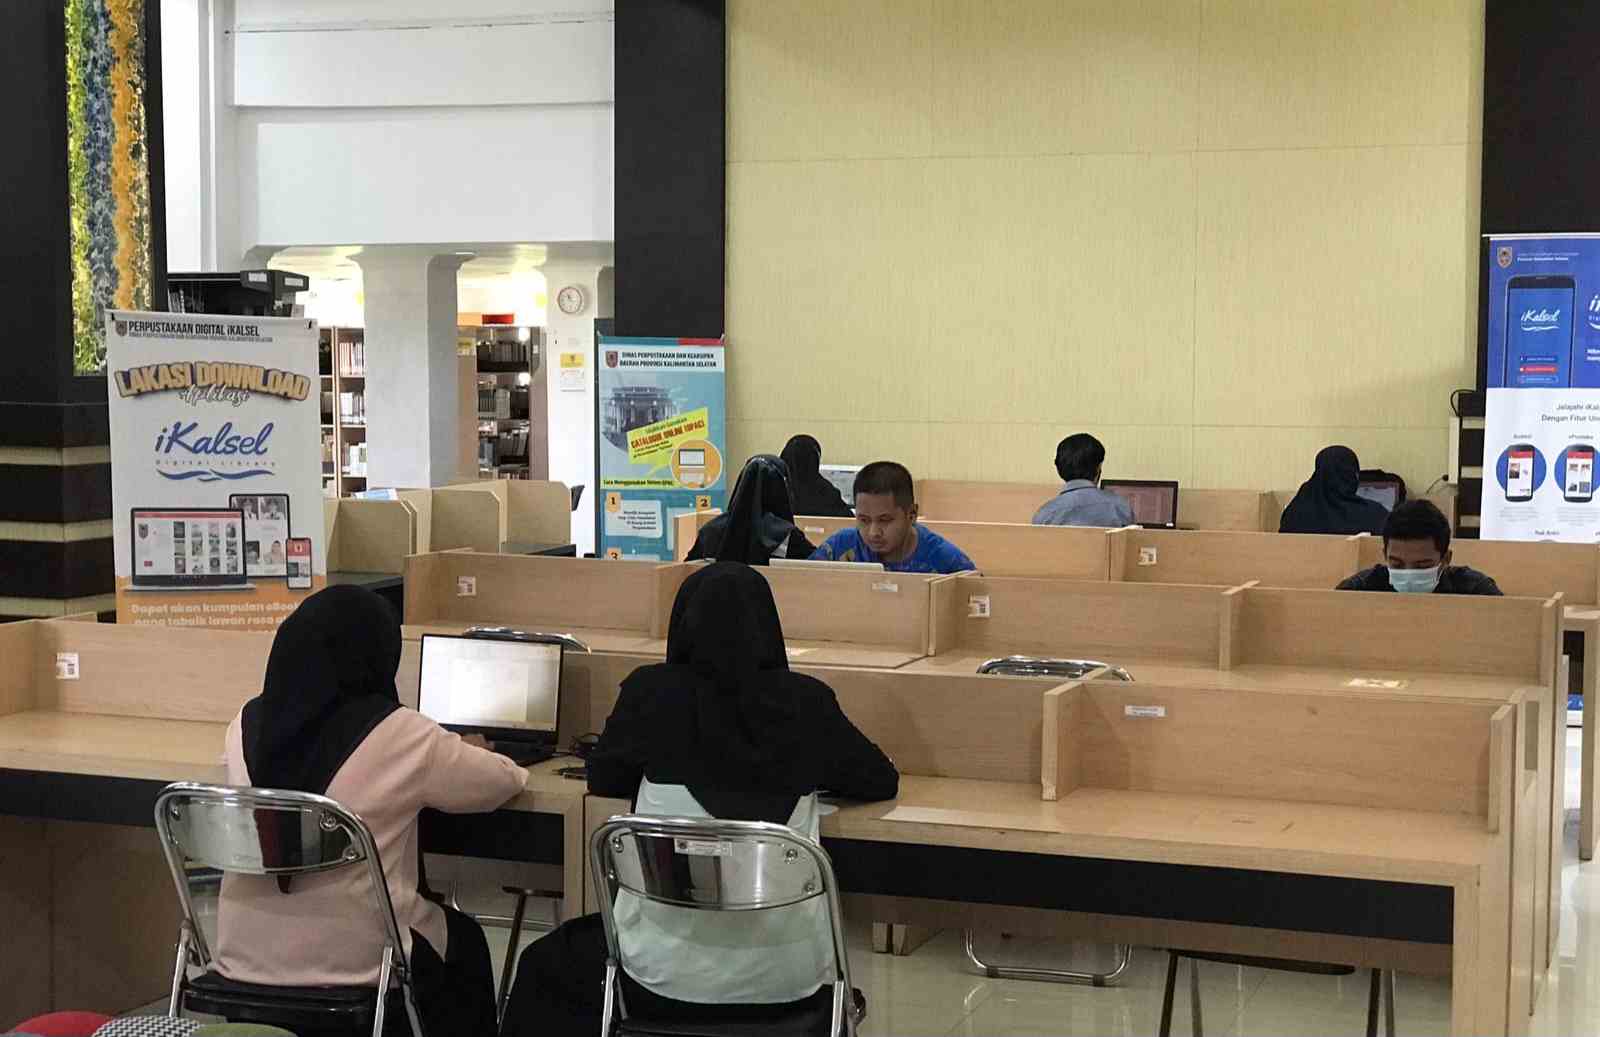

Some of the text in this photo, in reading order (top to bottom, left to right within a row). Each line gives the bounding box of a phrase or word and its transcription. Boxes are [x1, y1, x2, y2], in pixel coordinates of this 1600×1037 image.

[128, 320, 260, 337] PERPUSTAKAAN DIGITAL iKALSEL
[637, 351, 675, 360] PERPUSTAKAAN
[663, 360, 695, 368] KALIMANTAN
[114, 361, 311, 401] LAKASI DOWNLOAD
[179, 384, 249, 407] Aplikasi
[155, 421, 274, 455] iKalsel
[611, 496, 616, 505] 1
[700, 498, 709, 507] 2
[610, 551, 618, 560] 3
[130, 603, 169, 615] Dapat
[170, 602, 201, 613] akan
[203, 602, 265, 615] kumpulan
[208, 615, 246, 626] lawan
[247, 616, 274, 626] rasa
